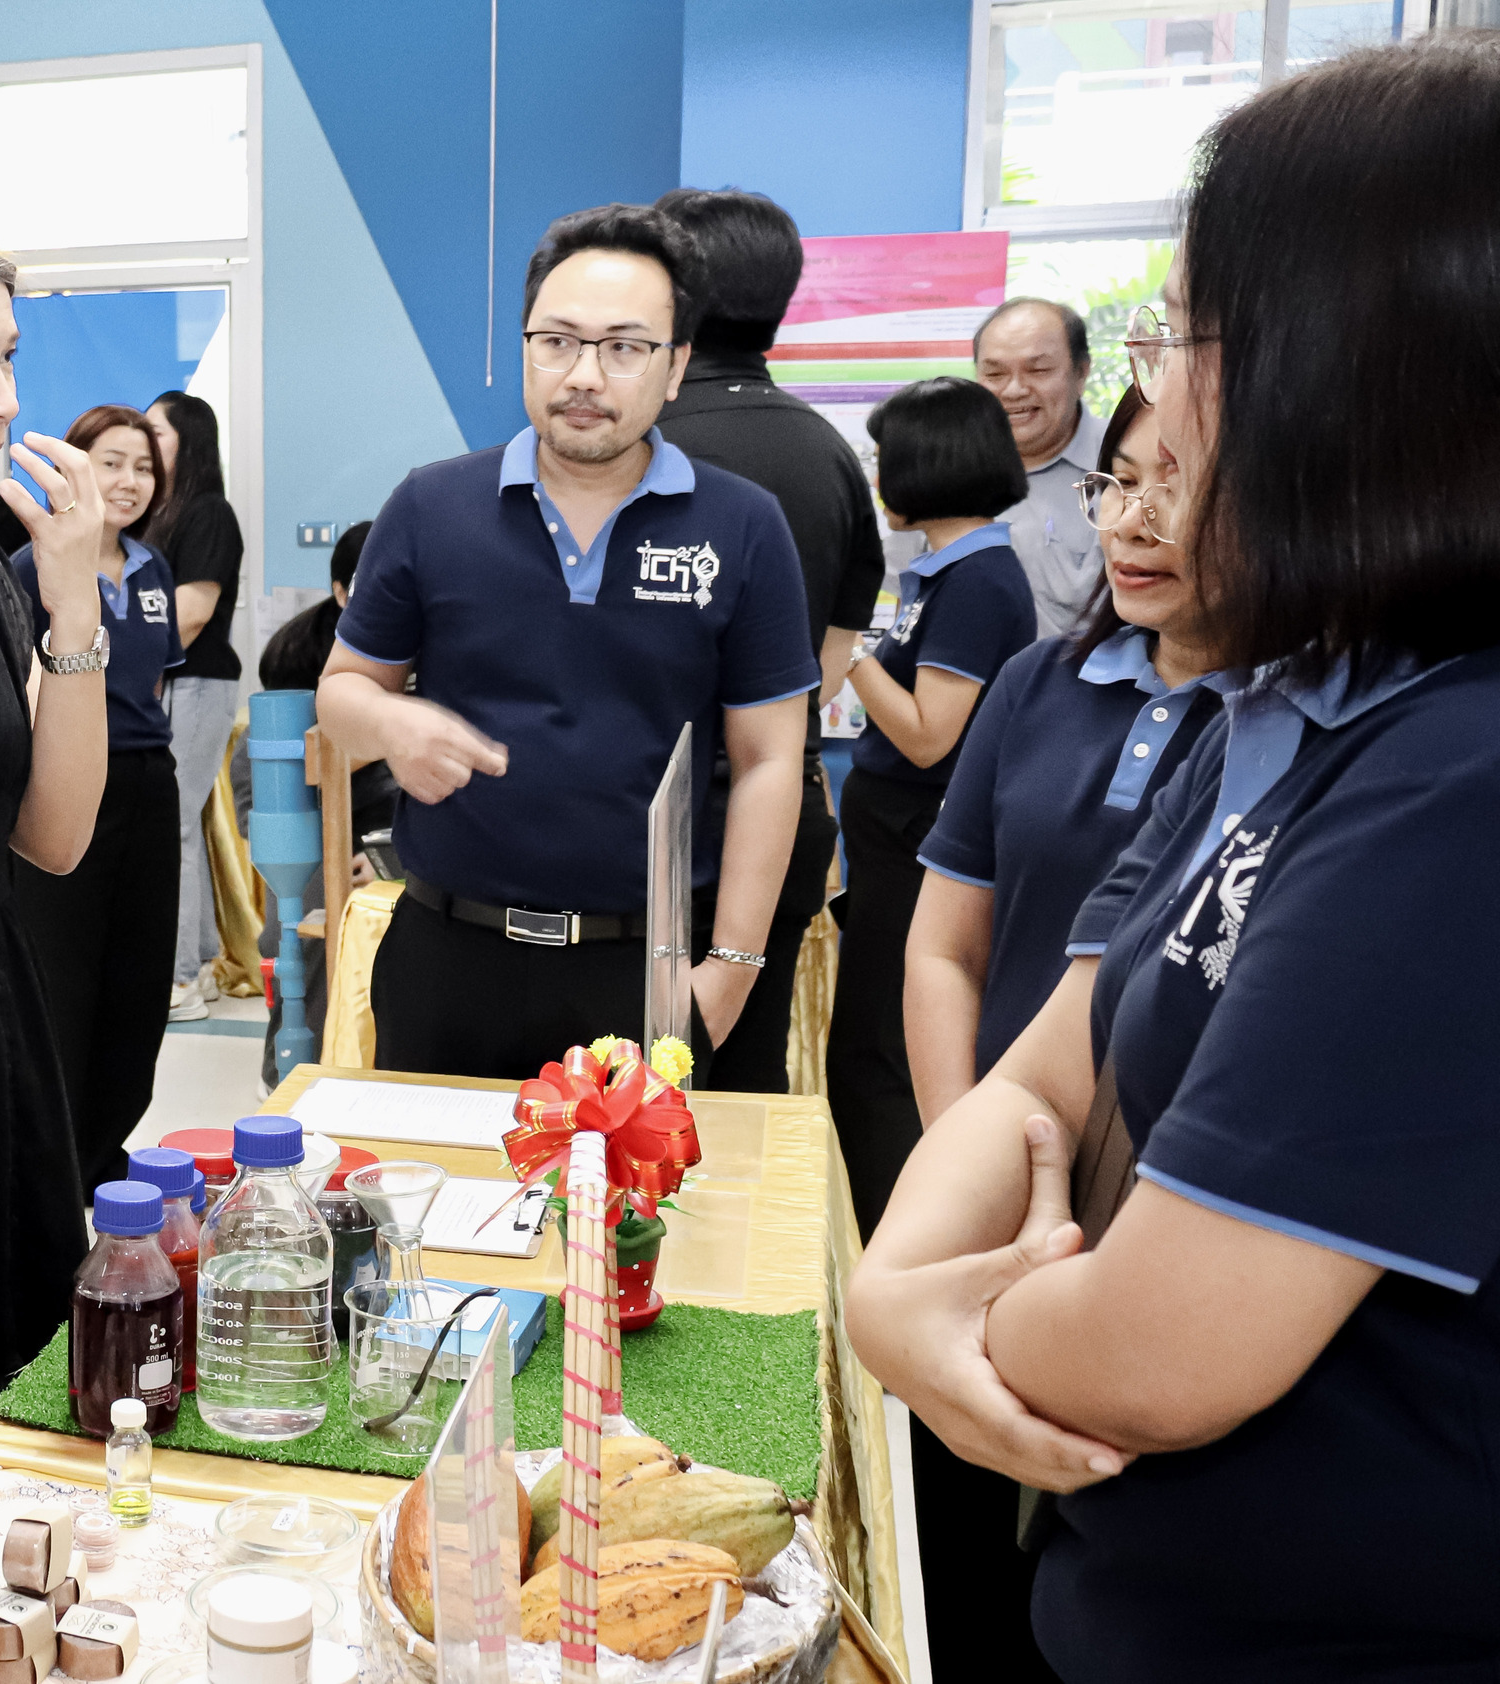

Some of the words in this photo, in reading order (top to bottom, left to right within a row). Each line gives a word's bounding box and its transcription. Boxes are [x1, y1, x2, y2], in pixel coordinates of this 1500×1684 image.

[149, 1342, 167, 1351] DURAN
[145, 1354, 160, 1364] 500
[160, 1352, 169, 1360] ml
[395, 1371, 411, 1379] 100
